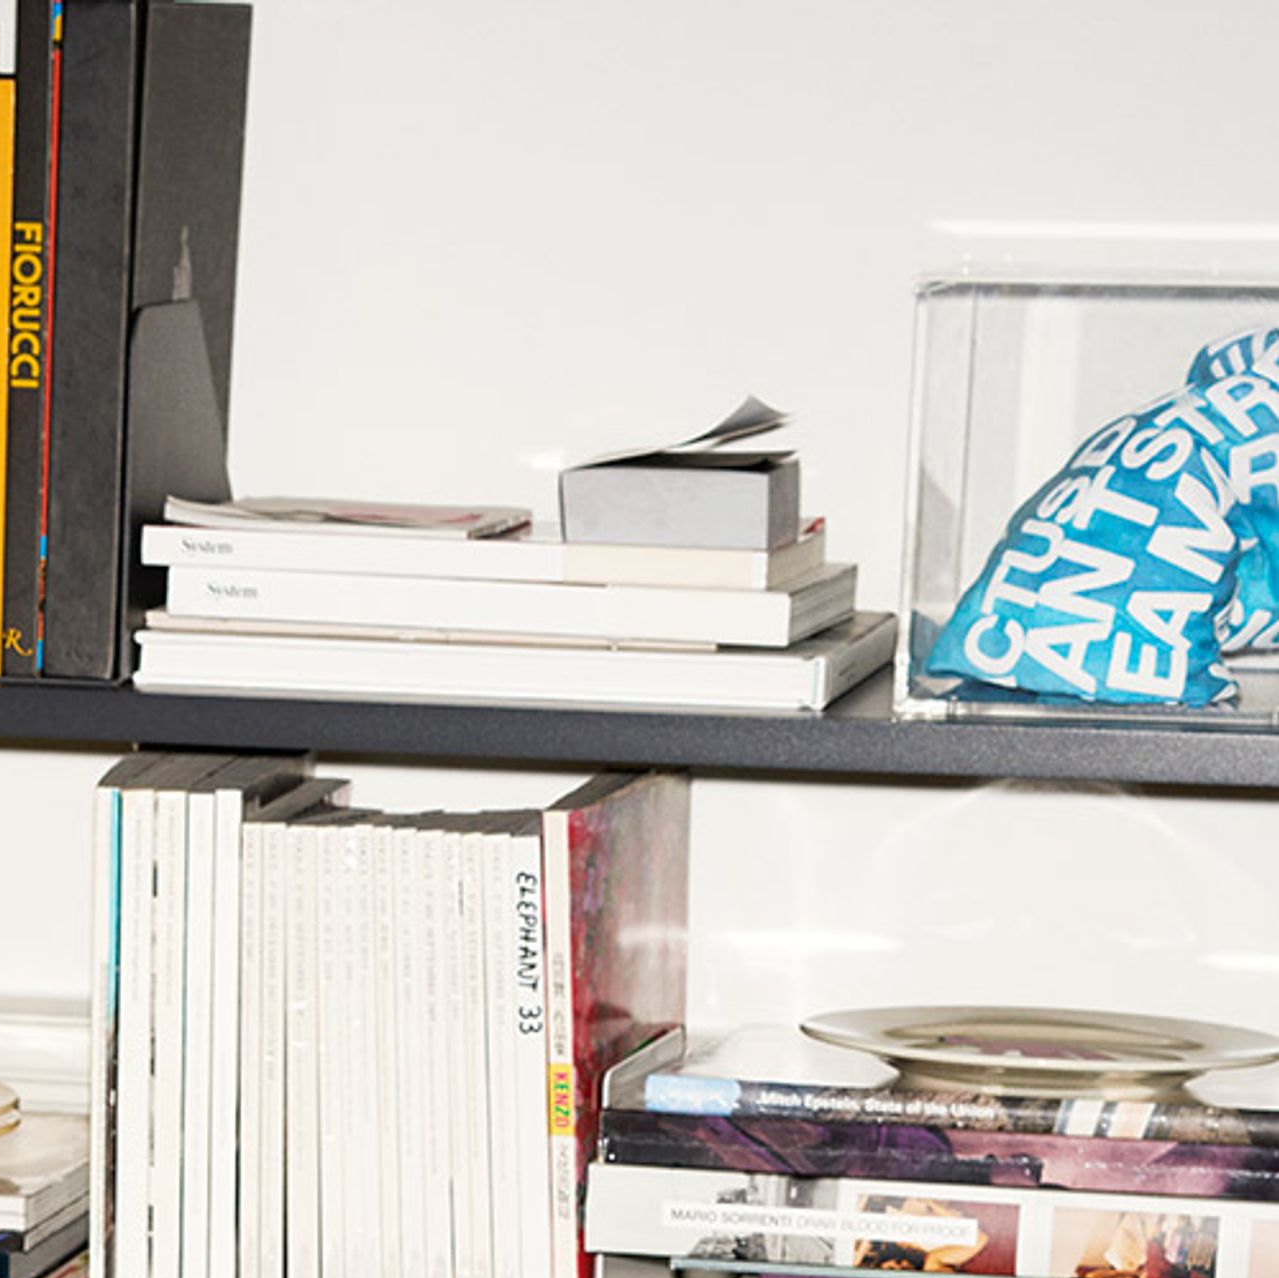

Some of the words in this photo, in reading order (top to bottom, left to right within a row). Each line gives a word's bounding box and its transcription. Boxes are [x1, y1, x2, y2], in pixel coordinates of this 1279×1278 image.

[10, 221, 43, 389] FIORUCCI
[180, 536, 234, 558] System
[205, 582, 259, 602] System
[516, 871, 539, 991] ELEPHANT
[518, 1005, 543, 1036] 33
[553, 1072, 569, 1129] KENZO
[671, 1208, 718, 1222] MARIO
[720, 1211, 792, 1228] SORRENTI
